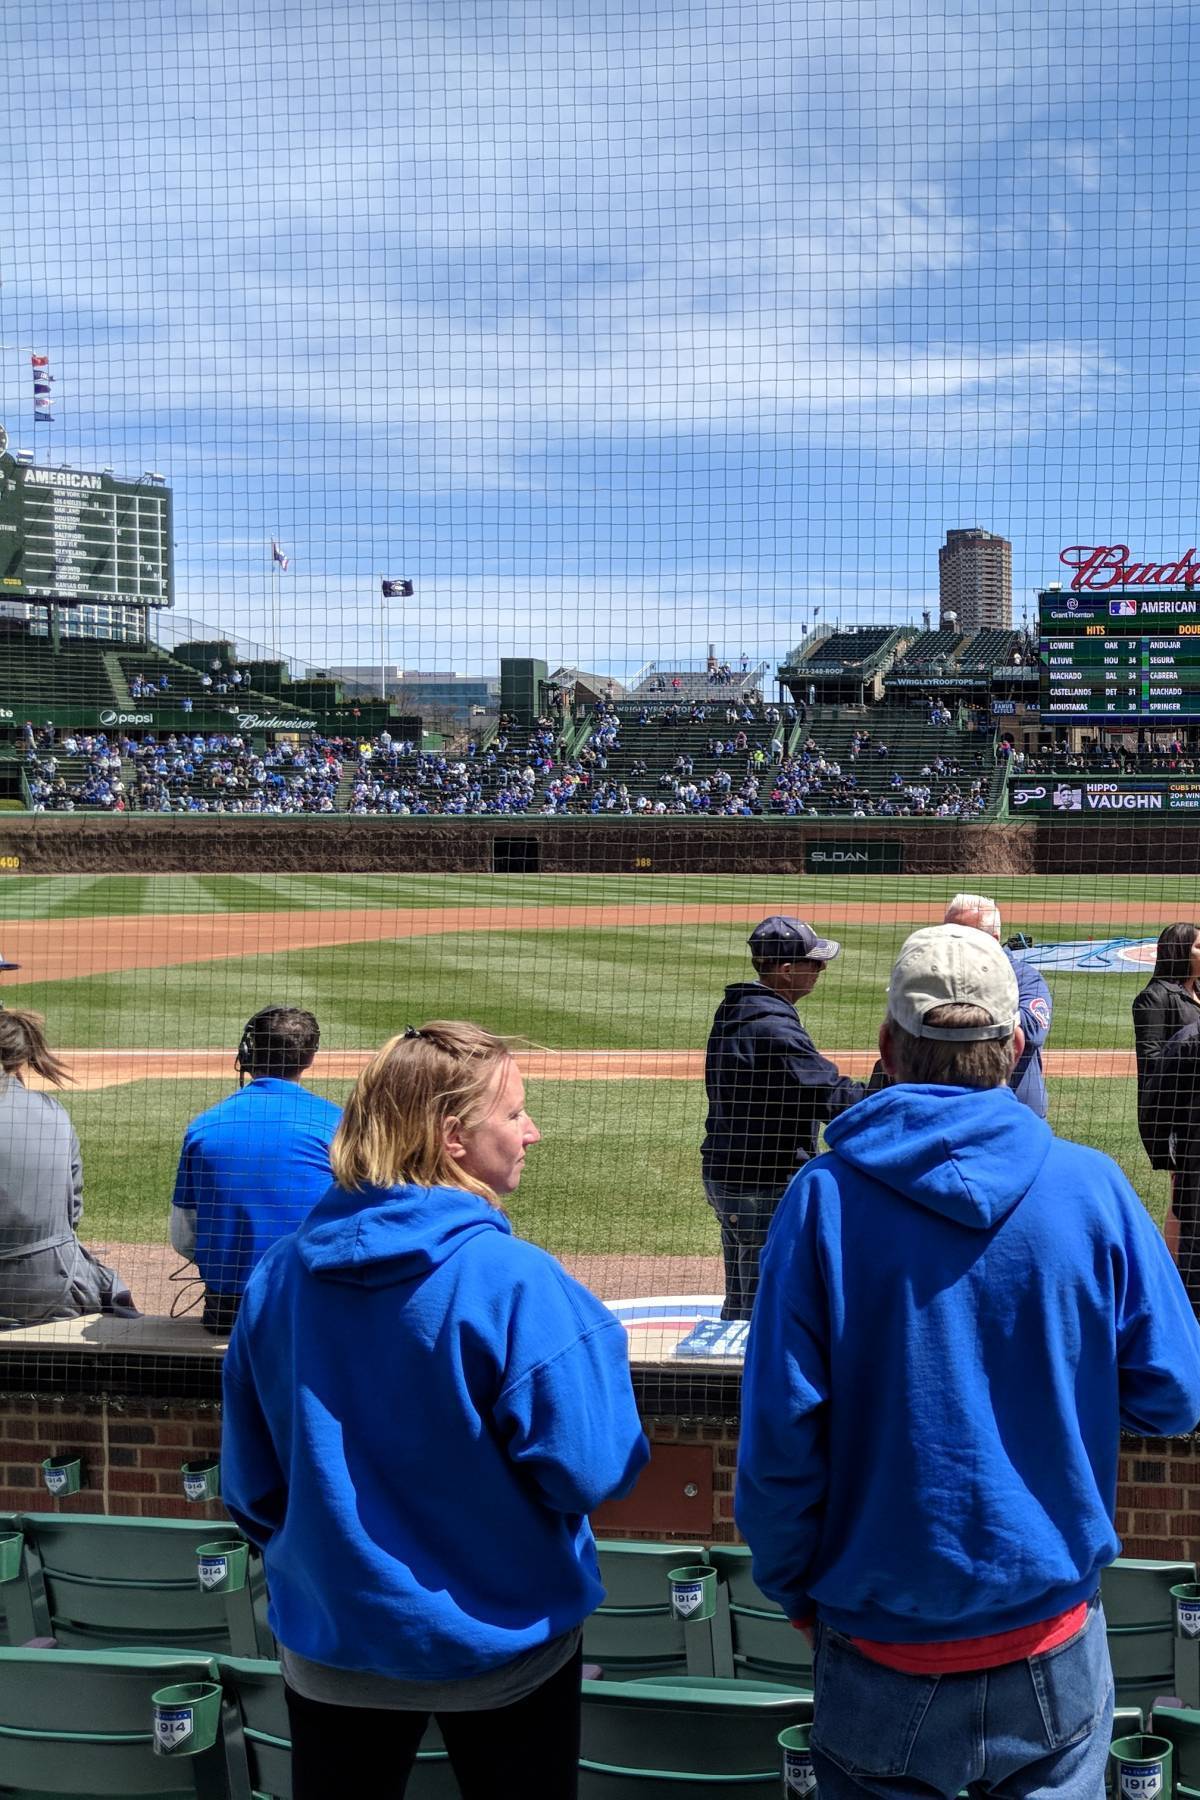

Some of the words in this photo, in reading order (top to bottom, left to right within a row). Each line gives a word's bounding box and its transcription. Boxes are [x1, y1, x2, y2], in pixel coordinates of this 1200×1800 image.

[24, 469, 102, 490] AMERICAN
[56, 548, 87, 556] CLEVELAND
[56, 574, 80, 582] CHICAGO
[1141, 601, 1196, 613] AMERICAN
[1068, 611, 1094, 619] Thornton
[1086, 626, 1105, 635] HITS
[1150, 641, 1181, 649] ANDUJAR
[1150, 656, 1174, 664] SEGURA
[1050, 688, 1092, 696] CASTELLANOS
[118, 712, 153, 725] pepsi
[236, 712, 318, 730] Budweiser
[1086, 784, 1118, 792] HIPPO
[1088, 795, 1162, 809] VAUGHN
[811, 852, 868, 861] SLOAN
[0, 857, 19, 868] 400
[674, 1592, 698, 1603] 1914
[1125, 1778, 1157, 1790] 1914
